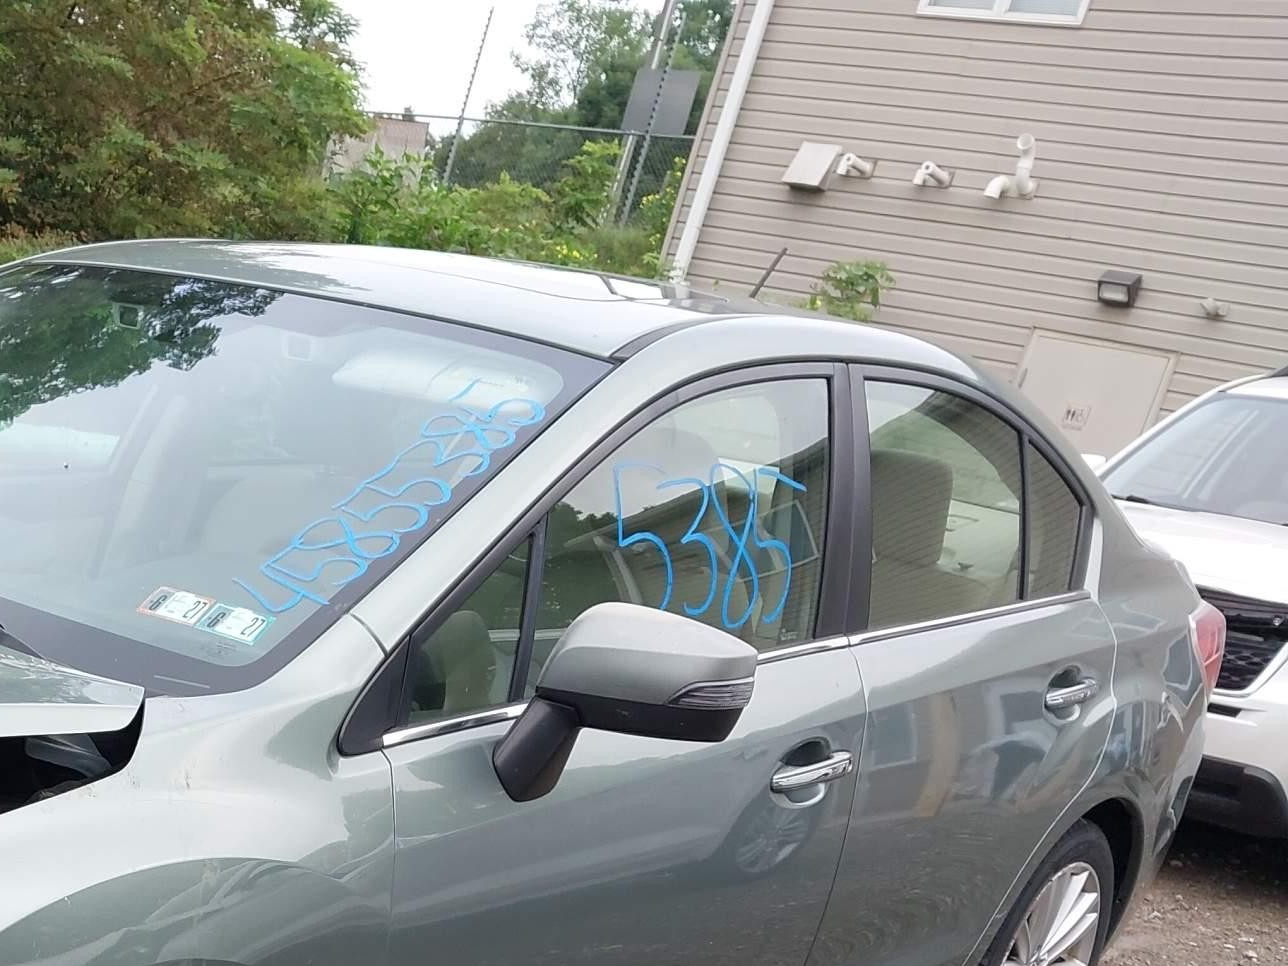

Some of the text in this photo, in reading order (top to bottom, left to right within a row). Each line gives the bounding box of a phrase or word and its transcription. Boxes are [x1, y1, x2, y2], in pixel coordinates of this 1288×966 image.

[613, 463, 808, 628] 5385
[182, 600, 208, 622] 27
[240, 617, 267, 638] 27
